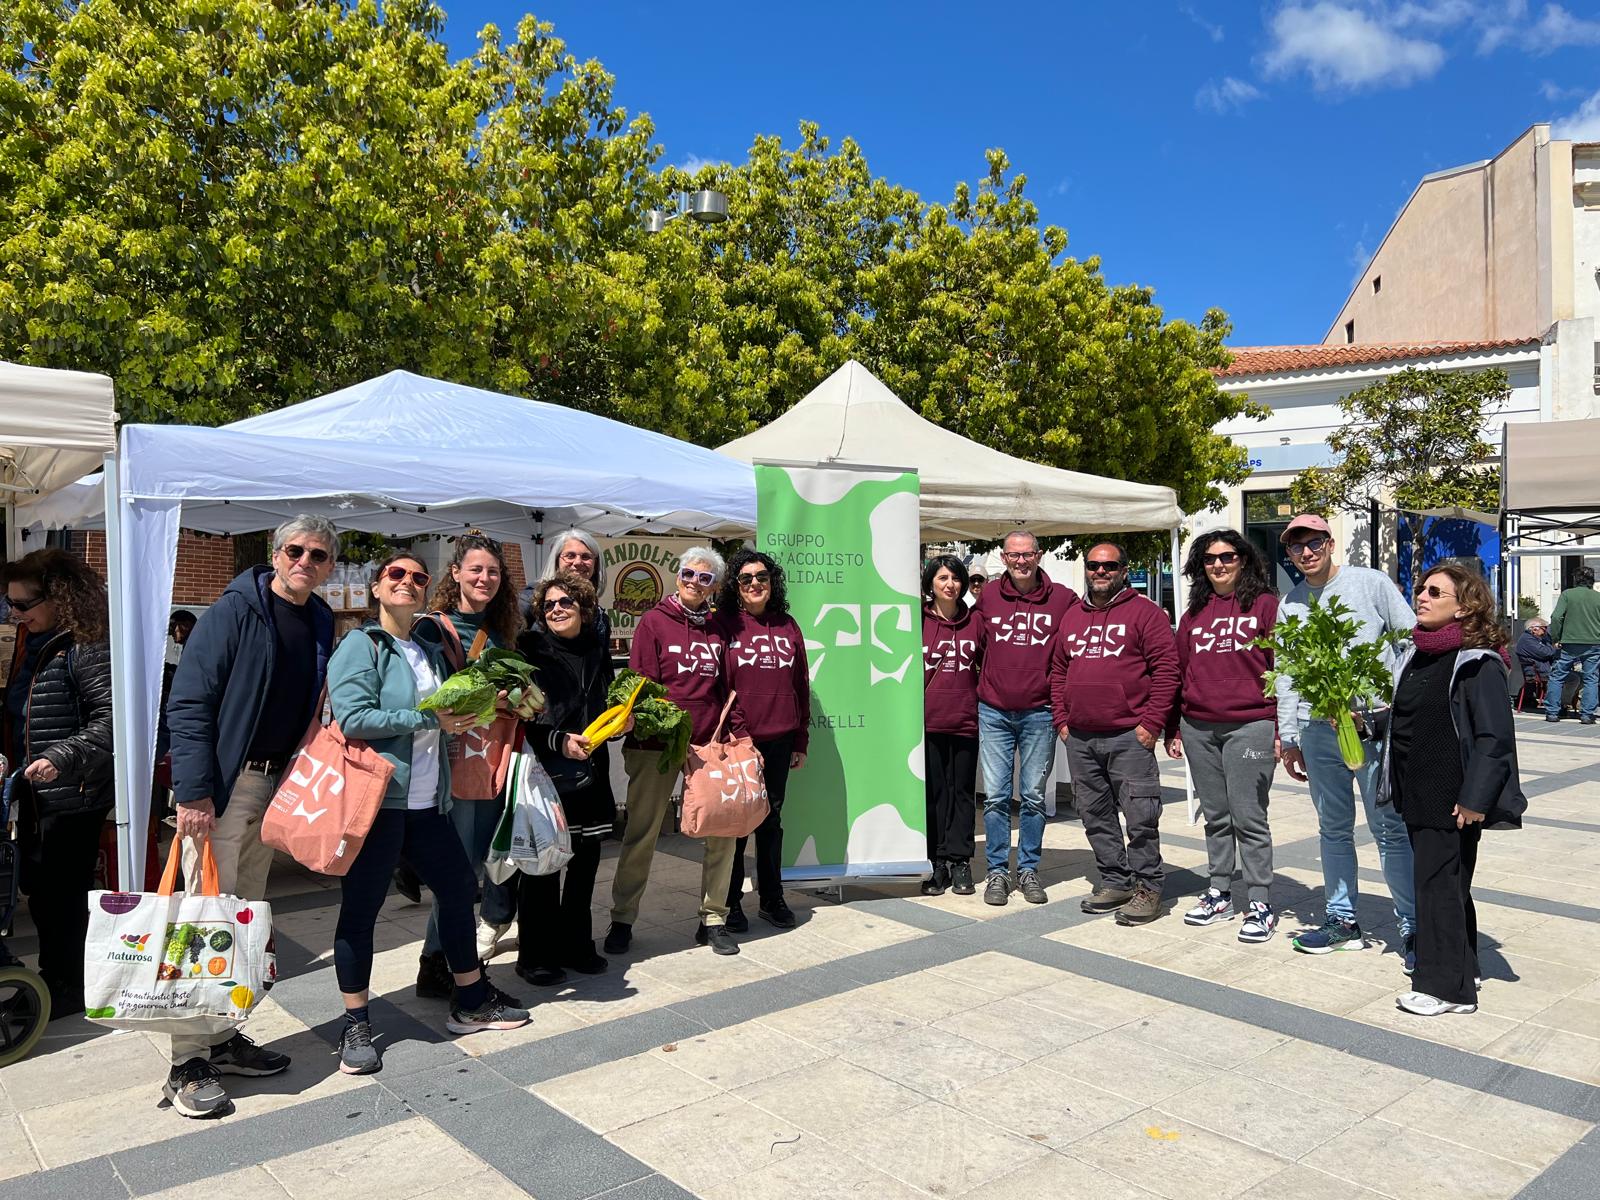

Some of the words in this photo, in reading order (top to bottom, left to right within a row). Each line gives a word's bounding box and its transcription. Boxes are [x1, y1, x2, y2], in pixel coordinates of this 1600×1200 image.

[767, 533, 825, 548] GRUPPO
[603, 542, 681, 574] ANDOLFO
[786, 571, 845, 584] LIDALE
[808, 714, 865, 729] ARELLI
[133, 992, 170, 1000] authentic
[172, 991, 192, 1000] taste
[132, 1003, 168, 1012] generous
